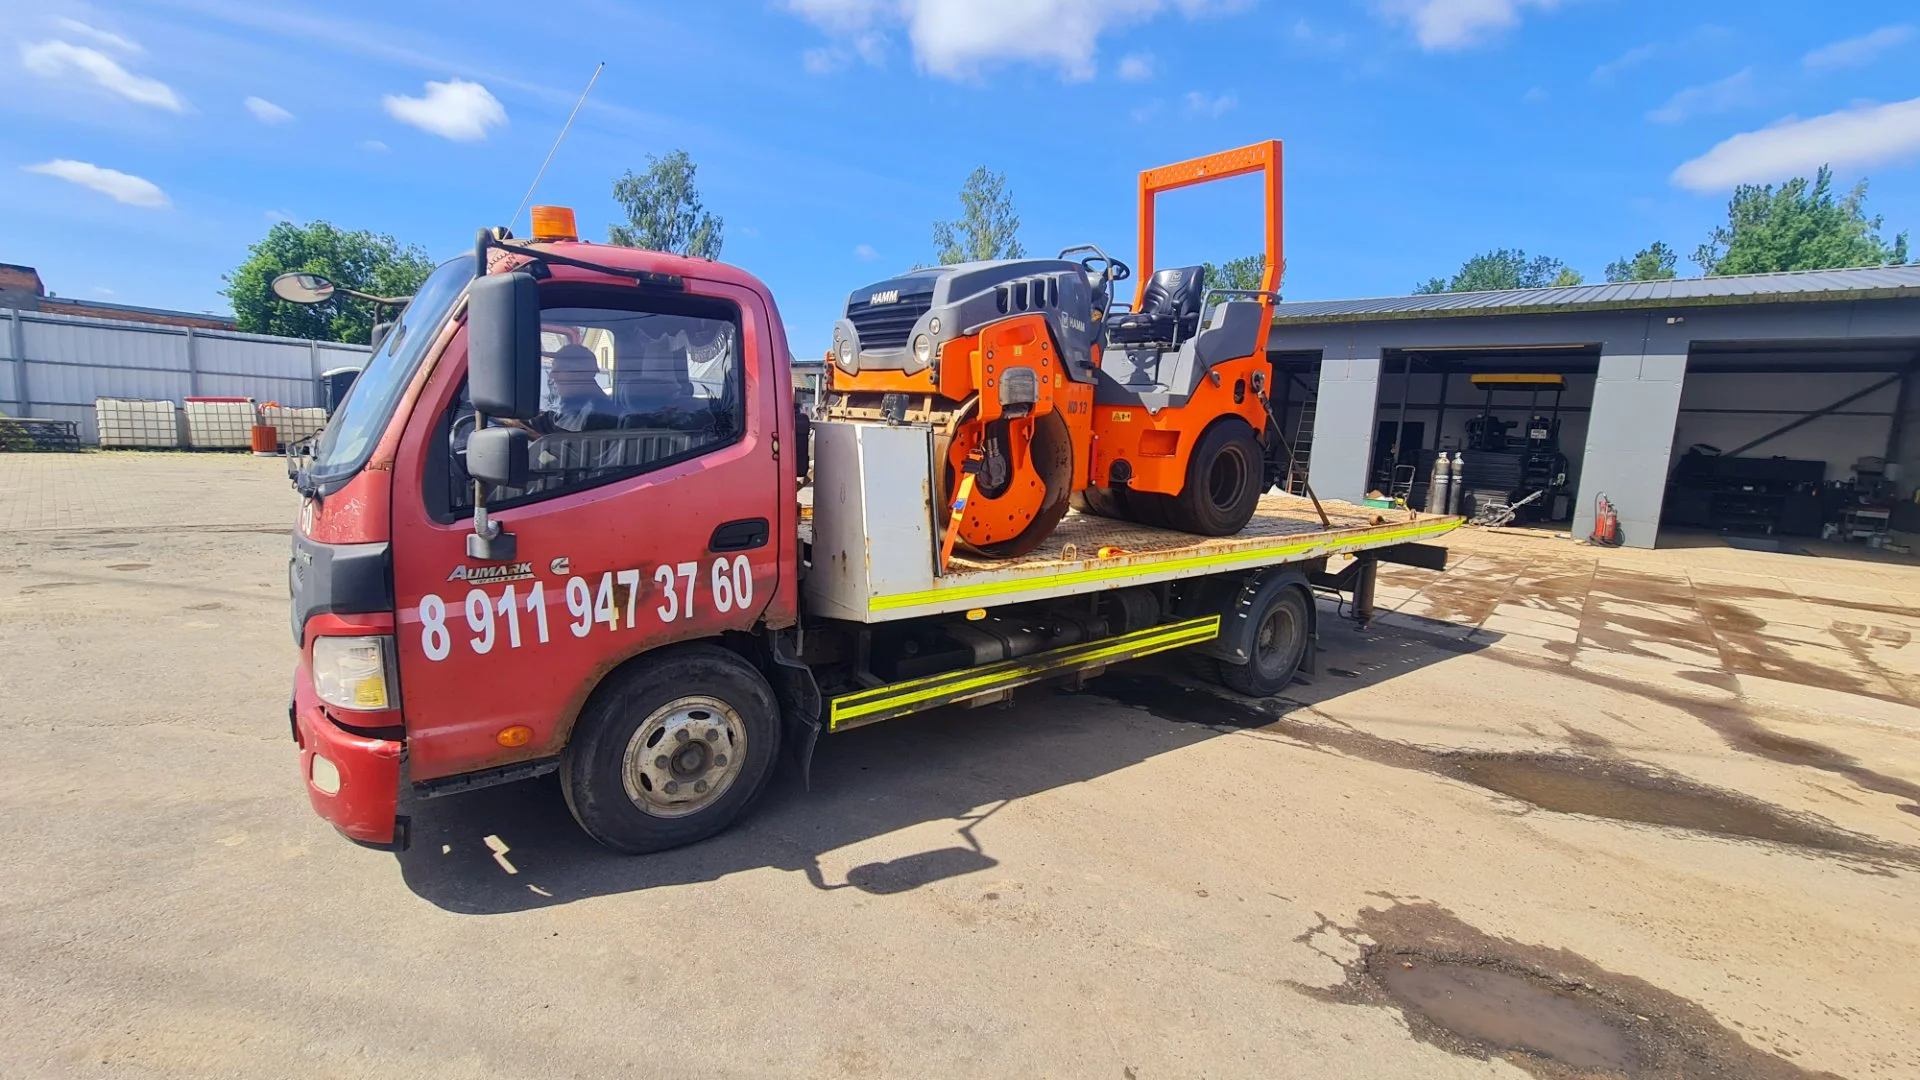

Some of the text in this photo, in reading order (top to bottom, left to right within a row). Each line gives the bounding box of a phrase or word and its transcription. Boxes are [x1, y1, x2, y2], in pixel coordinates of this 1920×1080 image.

[870, 289, 899, 304] HAMM
[1069, 316, 1086, 332] HAMM
[419, 554, 753, 661] 8 911 947 37 60
